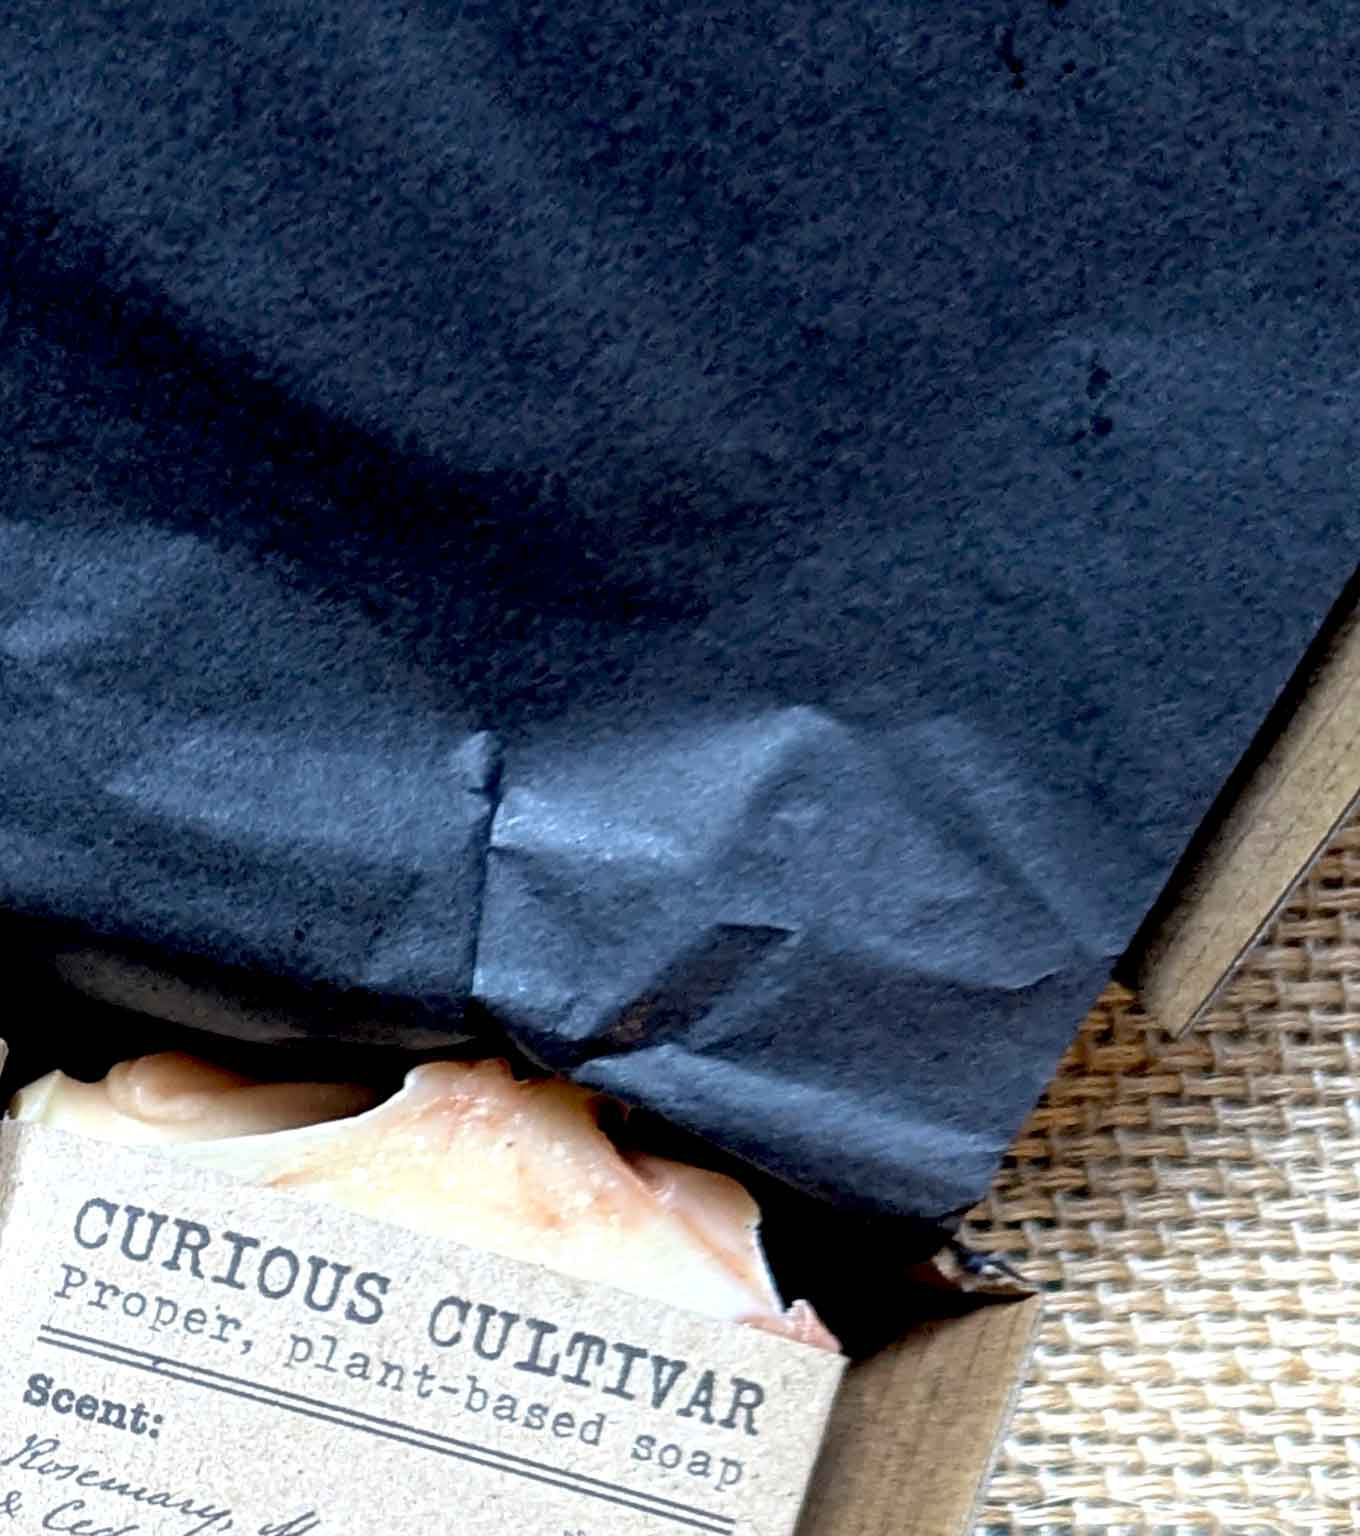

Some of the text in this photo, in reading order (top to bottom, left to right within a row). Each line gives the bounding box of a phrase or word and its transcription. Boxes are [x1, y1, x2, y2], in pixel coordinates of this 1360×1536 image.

[21, 1372, 164, 1440] Scent:
[53, 1262, 743, 1485] Proper, plant-based soap
[72, 1196, 765, 1436] CURIOUS CULTIVAR
